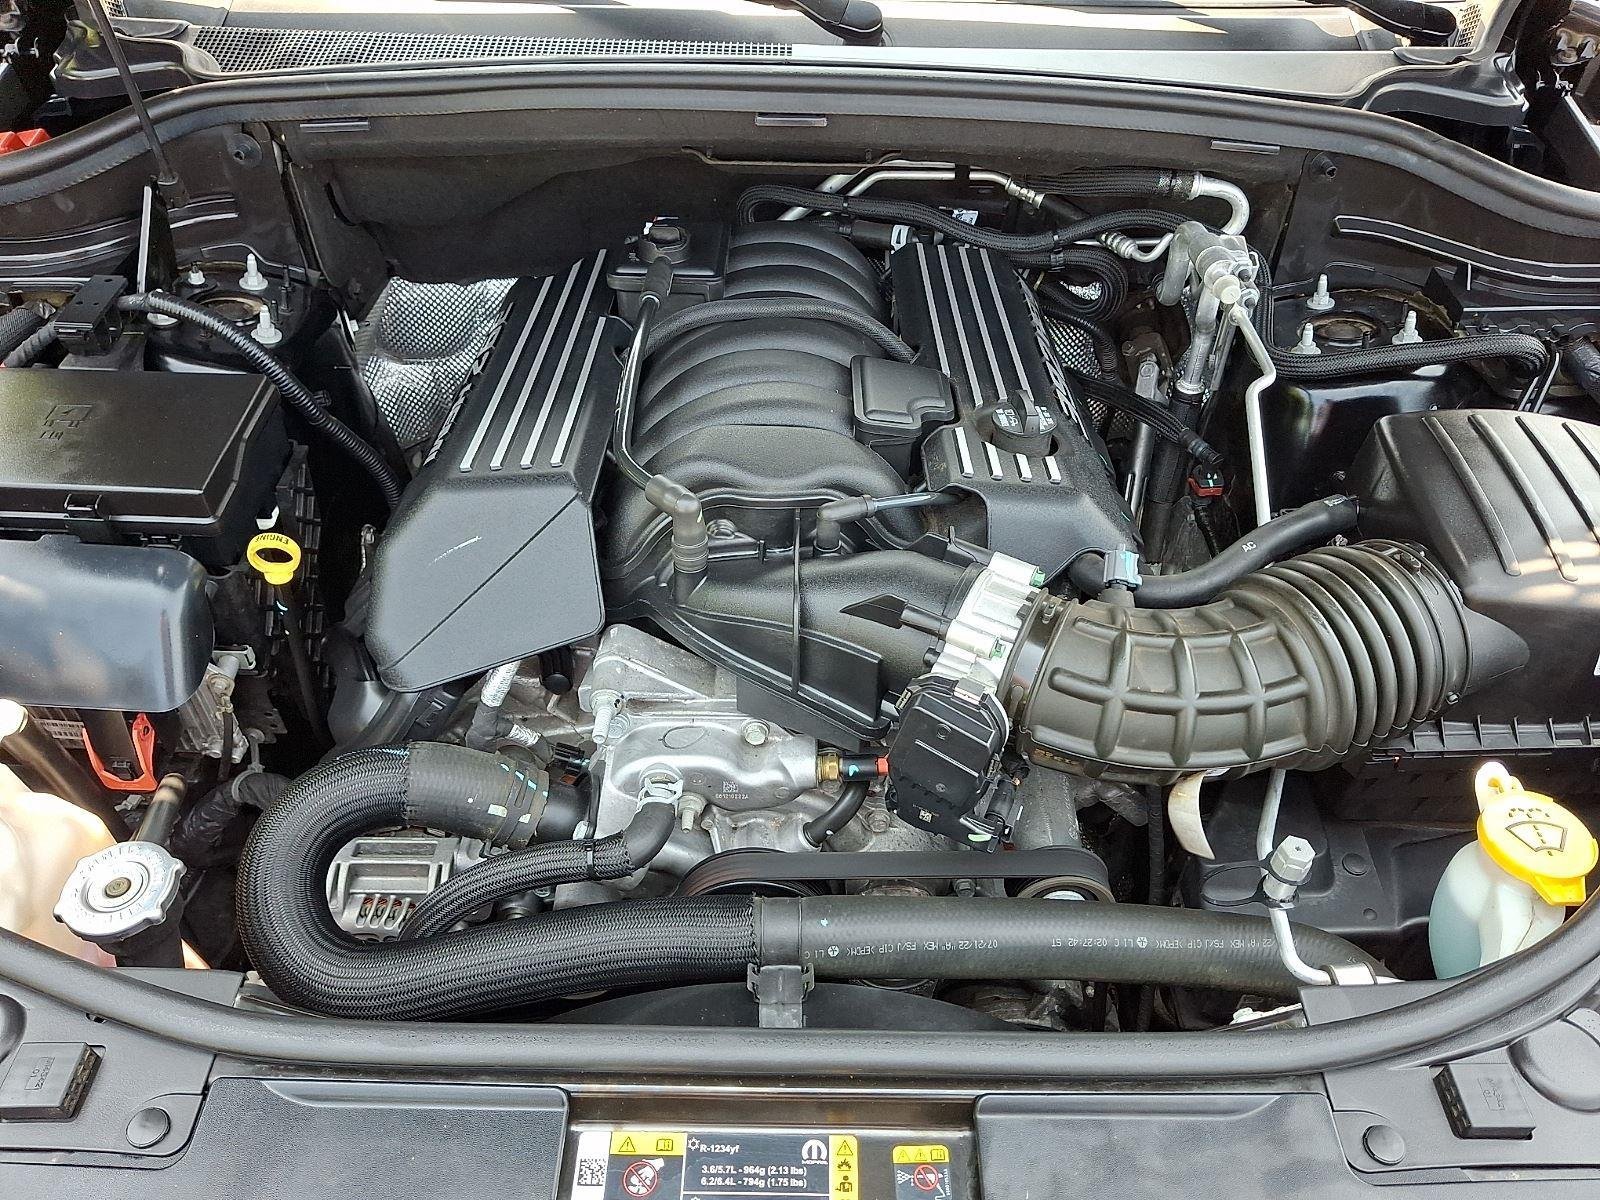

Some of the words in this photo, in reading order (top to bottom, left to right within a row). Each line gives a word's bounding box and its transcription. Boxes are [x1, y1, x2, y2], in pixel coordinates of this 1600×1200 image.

[463, 302, 514, 386] 392
[423, 382, 473, 466] HEMI
[255, 534, 289, 545] ENGINE
[1241, 541, 1257, 552] AC
[923, 940, 939, 951] MEX
[958, 938, 998, 950] 07/21/22
[1051, 938, 1062, 947] ST
[1068, 937, 1107, 948] 02:27:42
[1230, 939, 1245, 949] MEX
[699, 1144, 740, 1155] R-1234yf
[701, 1165, 737, 1174] 3.6/5.7L
[743, 1166, 766, 1176] 964g
[767, 1166, 789, 1176] (2.13
[790, 1166, 807, 1176] lbs)
[700, 1177, 736, 1186] 6.2/6.4L
[743, 1177, 766, 1188] 794g
[767, 1177, 789, 1188] (1.75
[790, 1178, 807, 1188] lbs)
